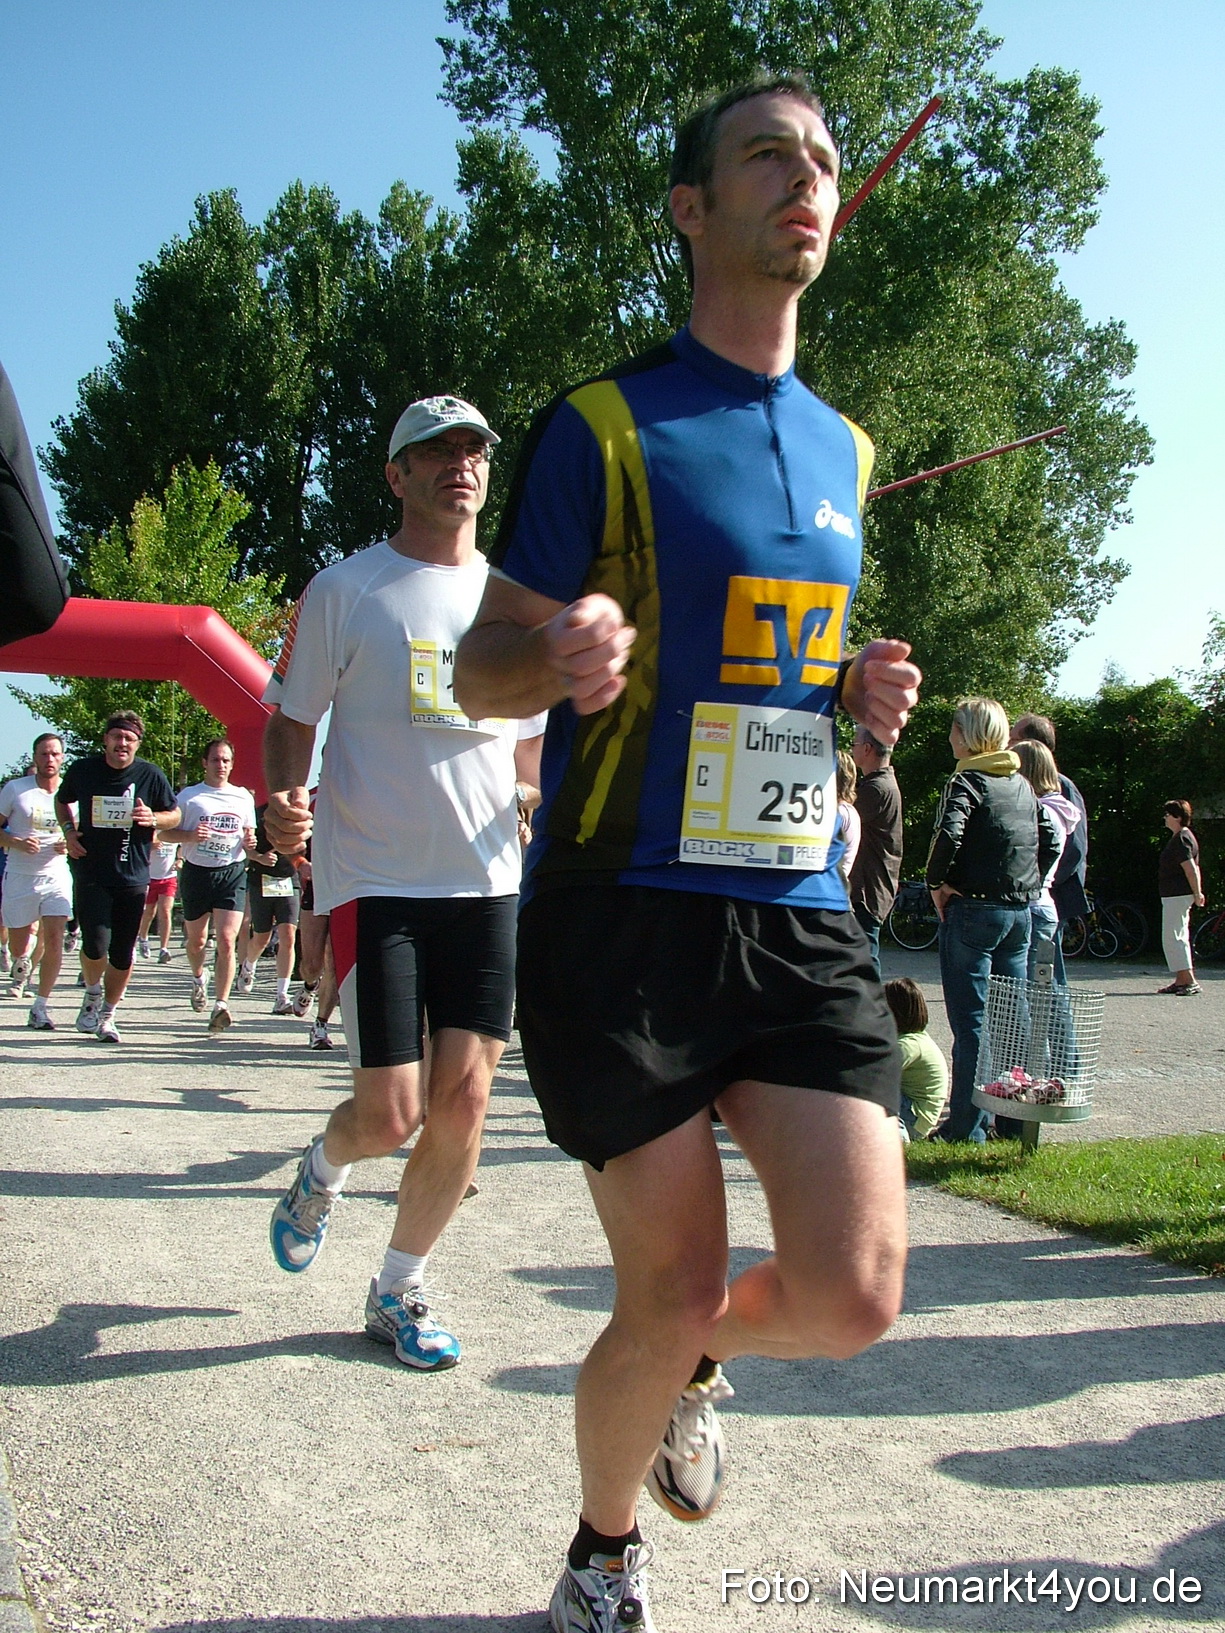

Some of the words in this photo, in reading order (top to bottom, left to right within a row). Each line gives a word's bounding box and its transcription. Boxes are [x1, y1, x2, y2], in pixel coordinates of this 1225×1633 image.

[417, 672, 424, 685] C
[413, 713, 456, 723] BOCK
[745, 721, 824, 758] Christian
[696, 765, 709, 787] C
[757, 780, 825, 825] 259
[107, 810, 127, 820] 727
[208, 841, 231, 853] 2565
[683, 838, 756, 858] BOCK
